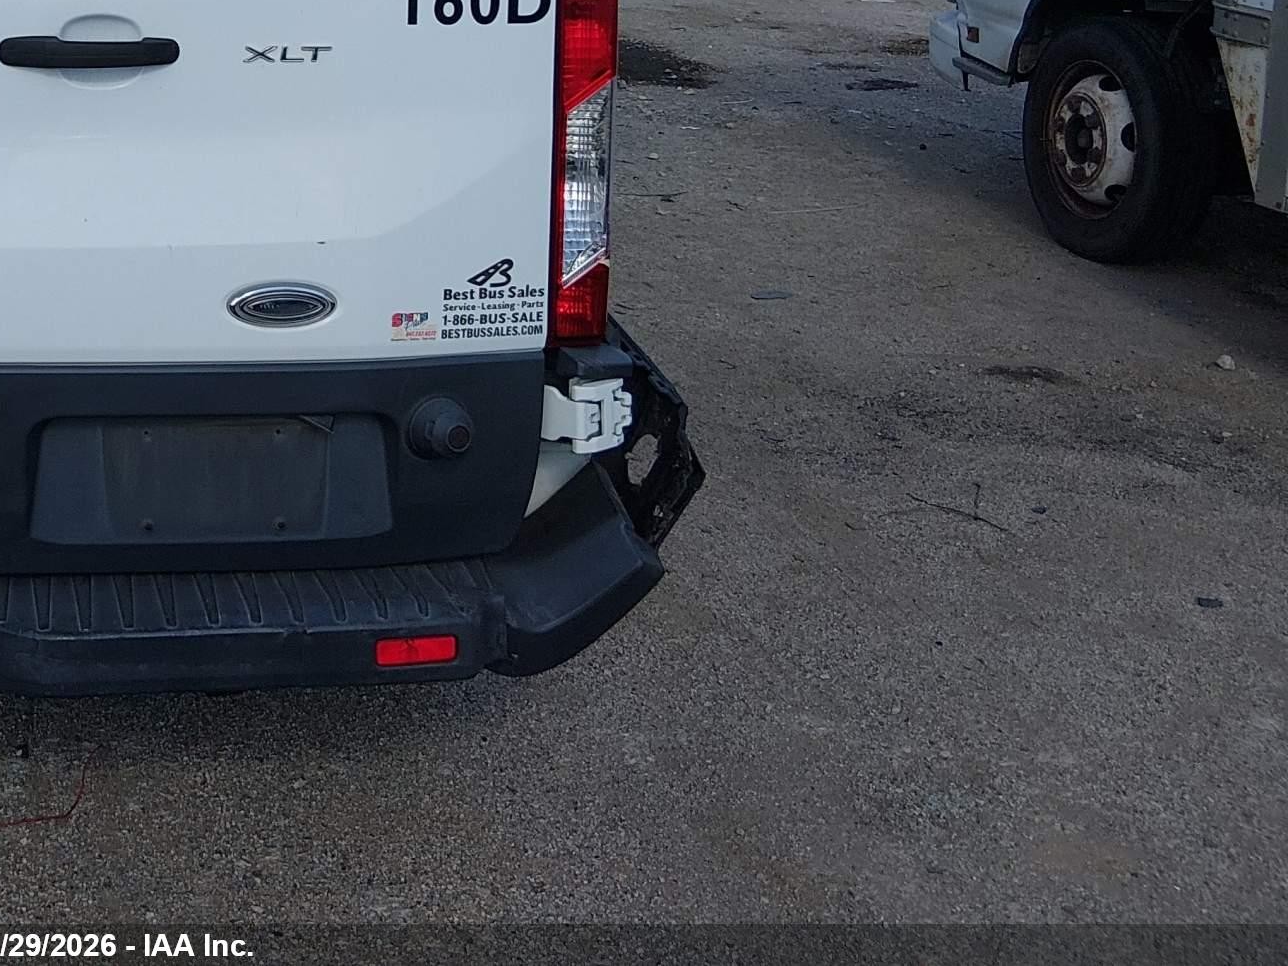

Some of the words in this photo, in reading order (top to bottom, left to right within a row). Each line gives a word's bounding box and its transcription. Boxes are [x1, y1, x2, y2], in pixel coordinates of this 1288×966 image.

[242, 45, 333, 63] XLT
[443, 288, 475, 301] Best
[478, 287, 504, 300] Bus
[507, 284, 545, 299] Sales
[441, 311, 544, 326] 1-866-BUS-SALE
[441, 325, 544, 339] BESTBUSSALES.COM
